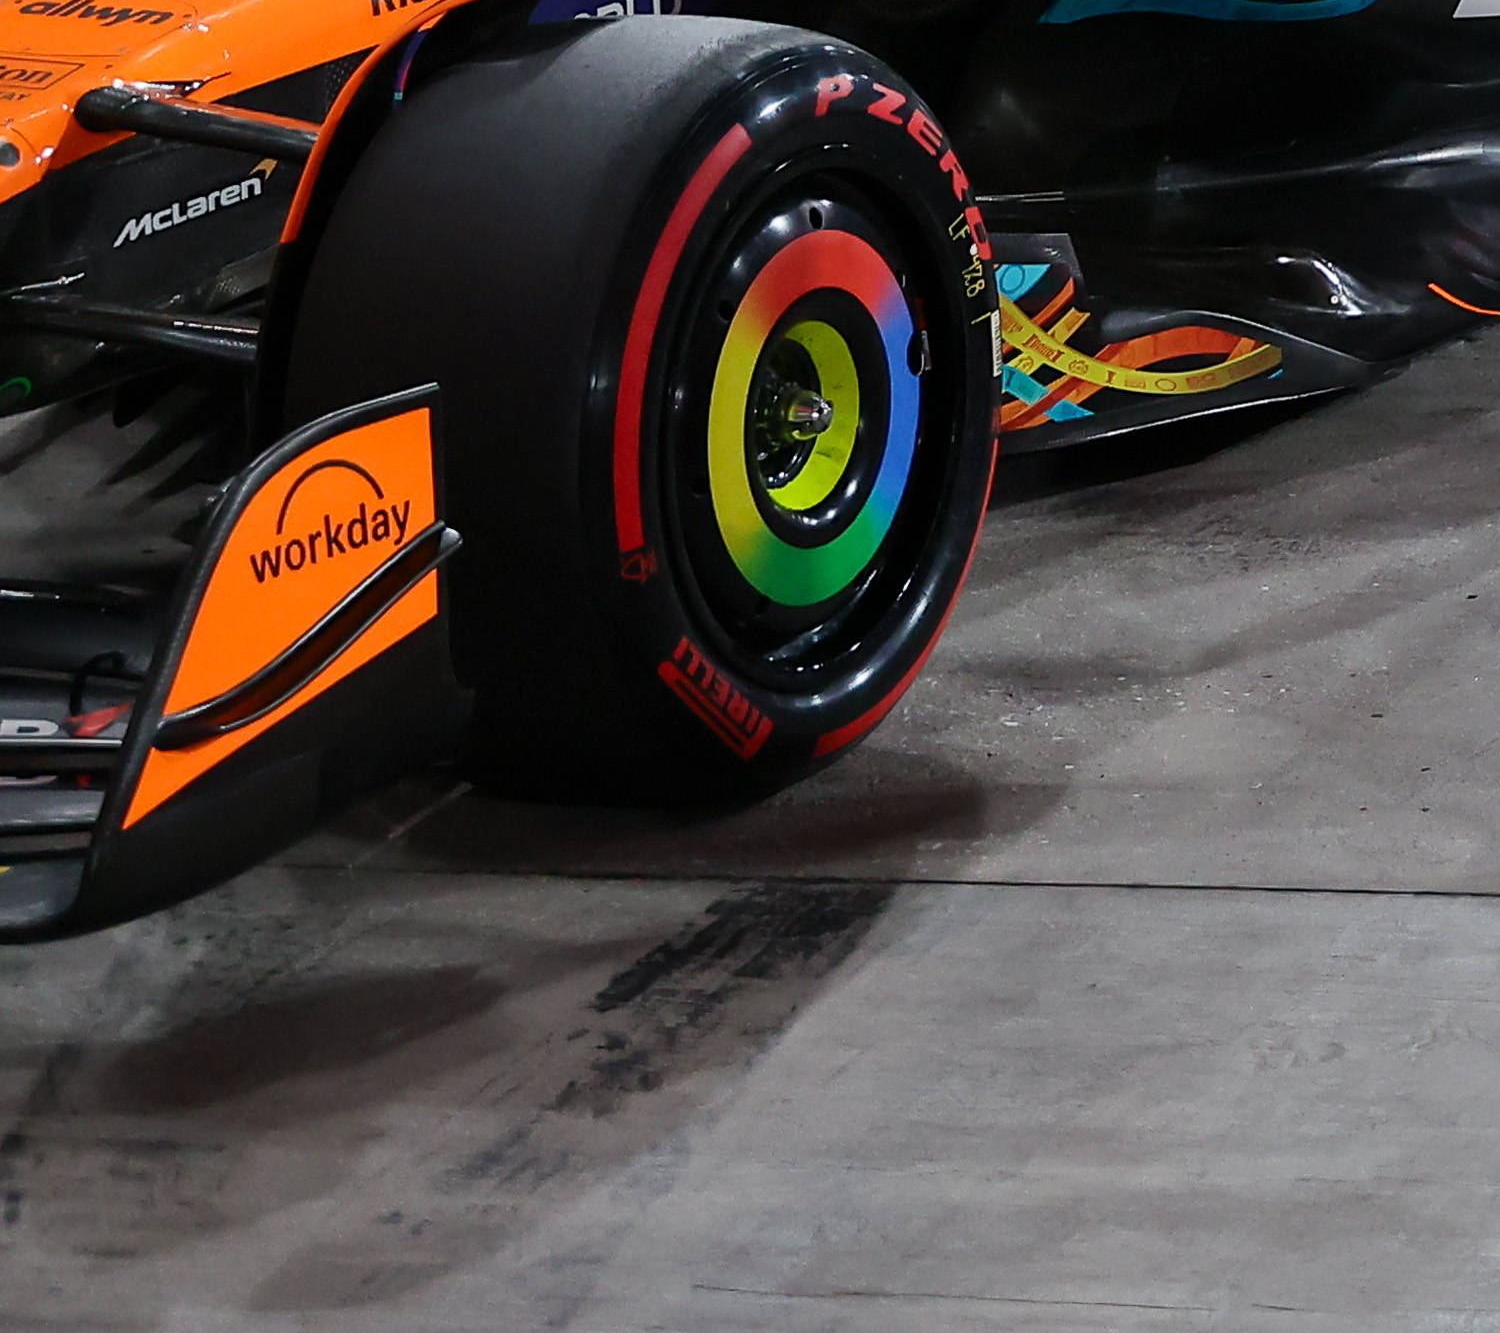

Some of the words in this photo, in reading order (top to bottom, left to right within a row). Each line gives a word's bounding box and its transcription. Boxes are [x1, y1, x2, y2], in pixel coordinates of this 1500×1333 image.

[112, 173, 264, 249] McLaren
[815, 74, 853, 119] P
[864, 78, 995, 263] ZERO
[248, 498, 411, 585] workday
